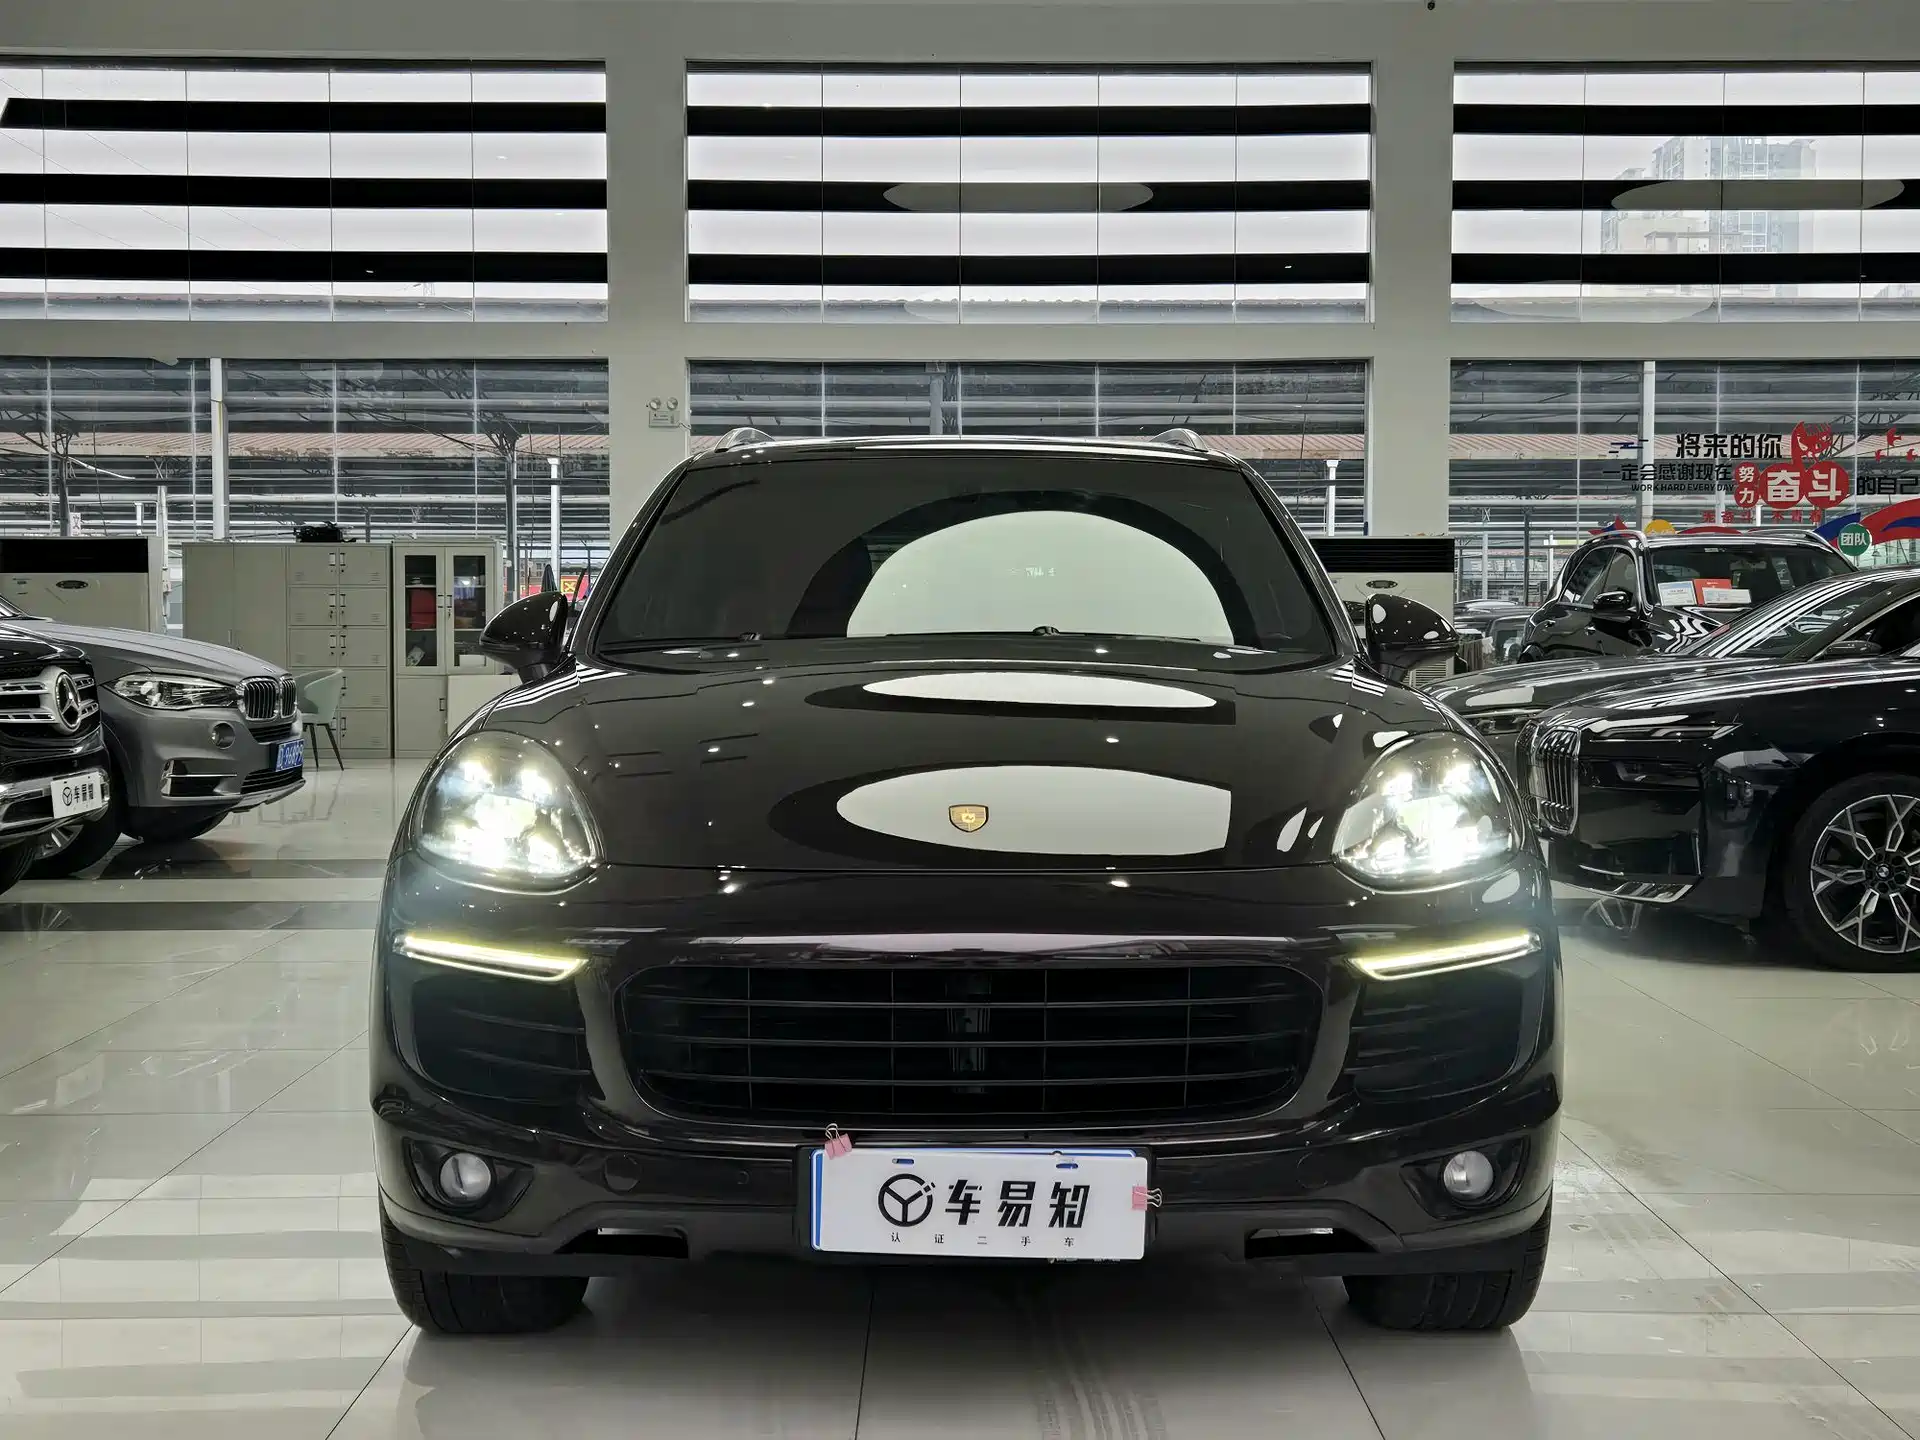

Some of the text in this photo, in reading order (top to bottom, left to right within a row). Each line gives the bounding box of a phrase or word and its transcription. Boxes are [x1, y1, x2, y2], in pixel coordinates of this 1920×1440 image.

[1676, 432, 1782, 459] 将来的你
[1602, 463, 1733, 481] 一定会感谢现在
[1738, 466, 1756, 504] 努力
[1766, 467, 1842, 502] 奋斗
[1632, 483, 1735, 492] WORK HARD EVERY DAY
[1840, 532, 1867, 546] 团队
[944, 1179, 1091, 1229] 车易知
[890, 1231, 1076, 1248] 认证二手车
